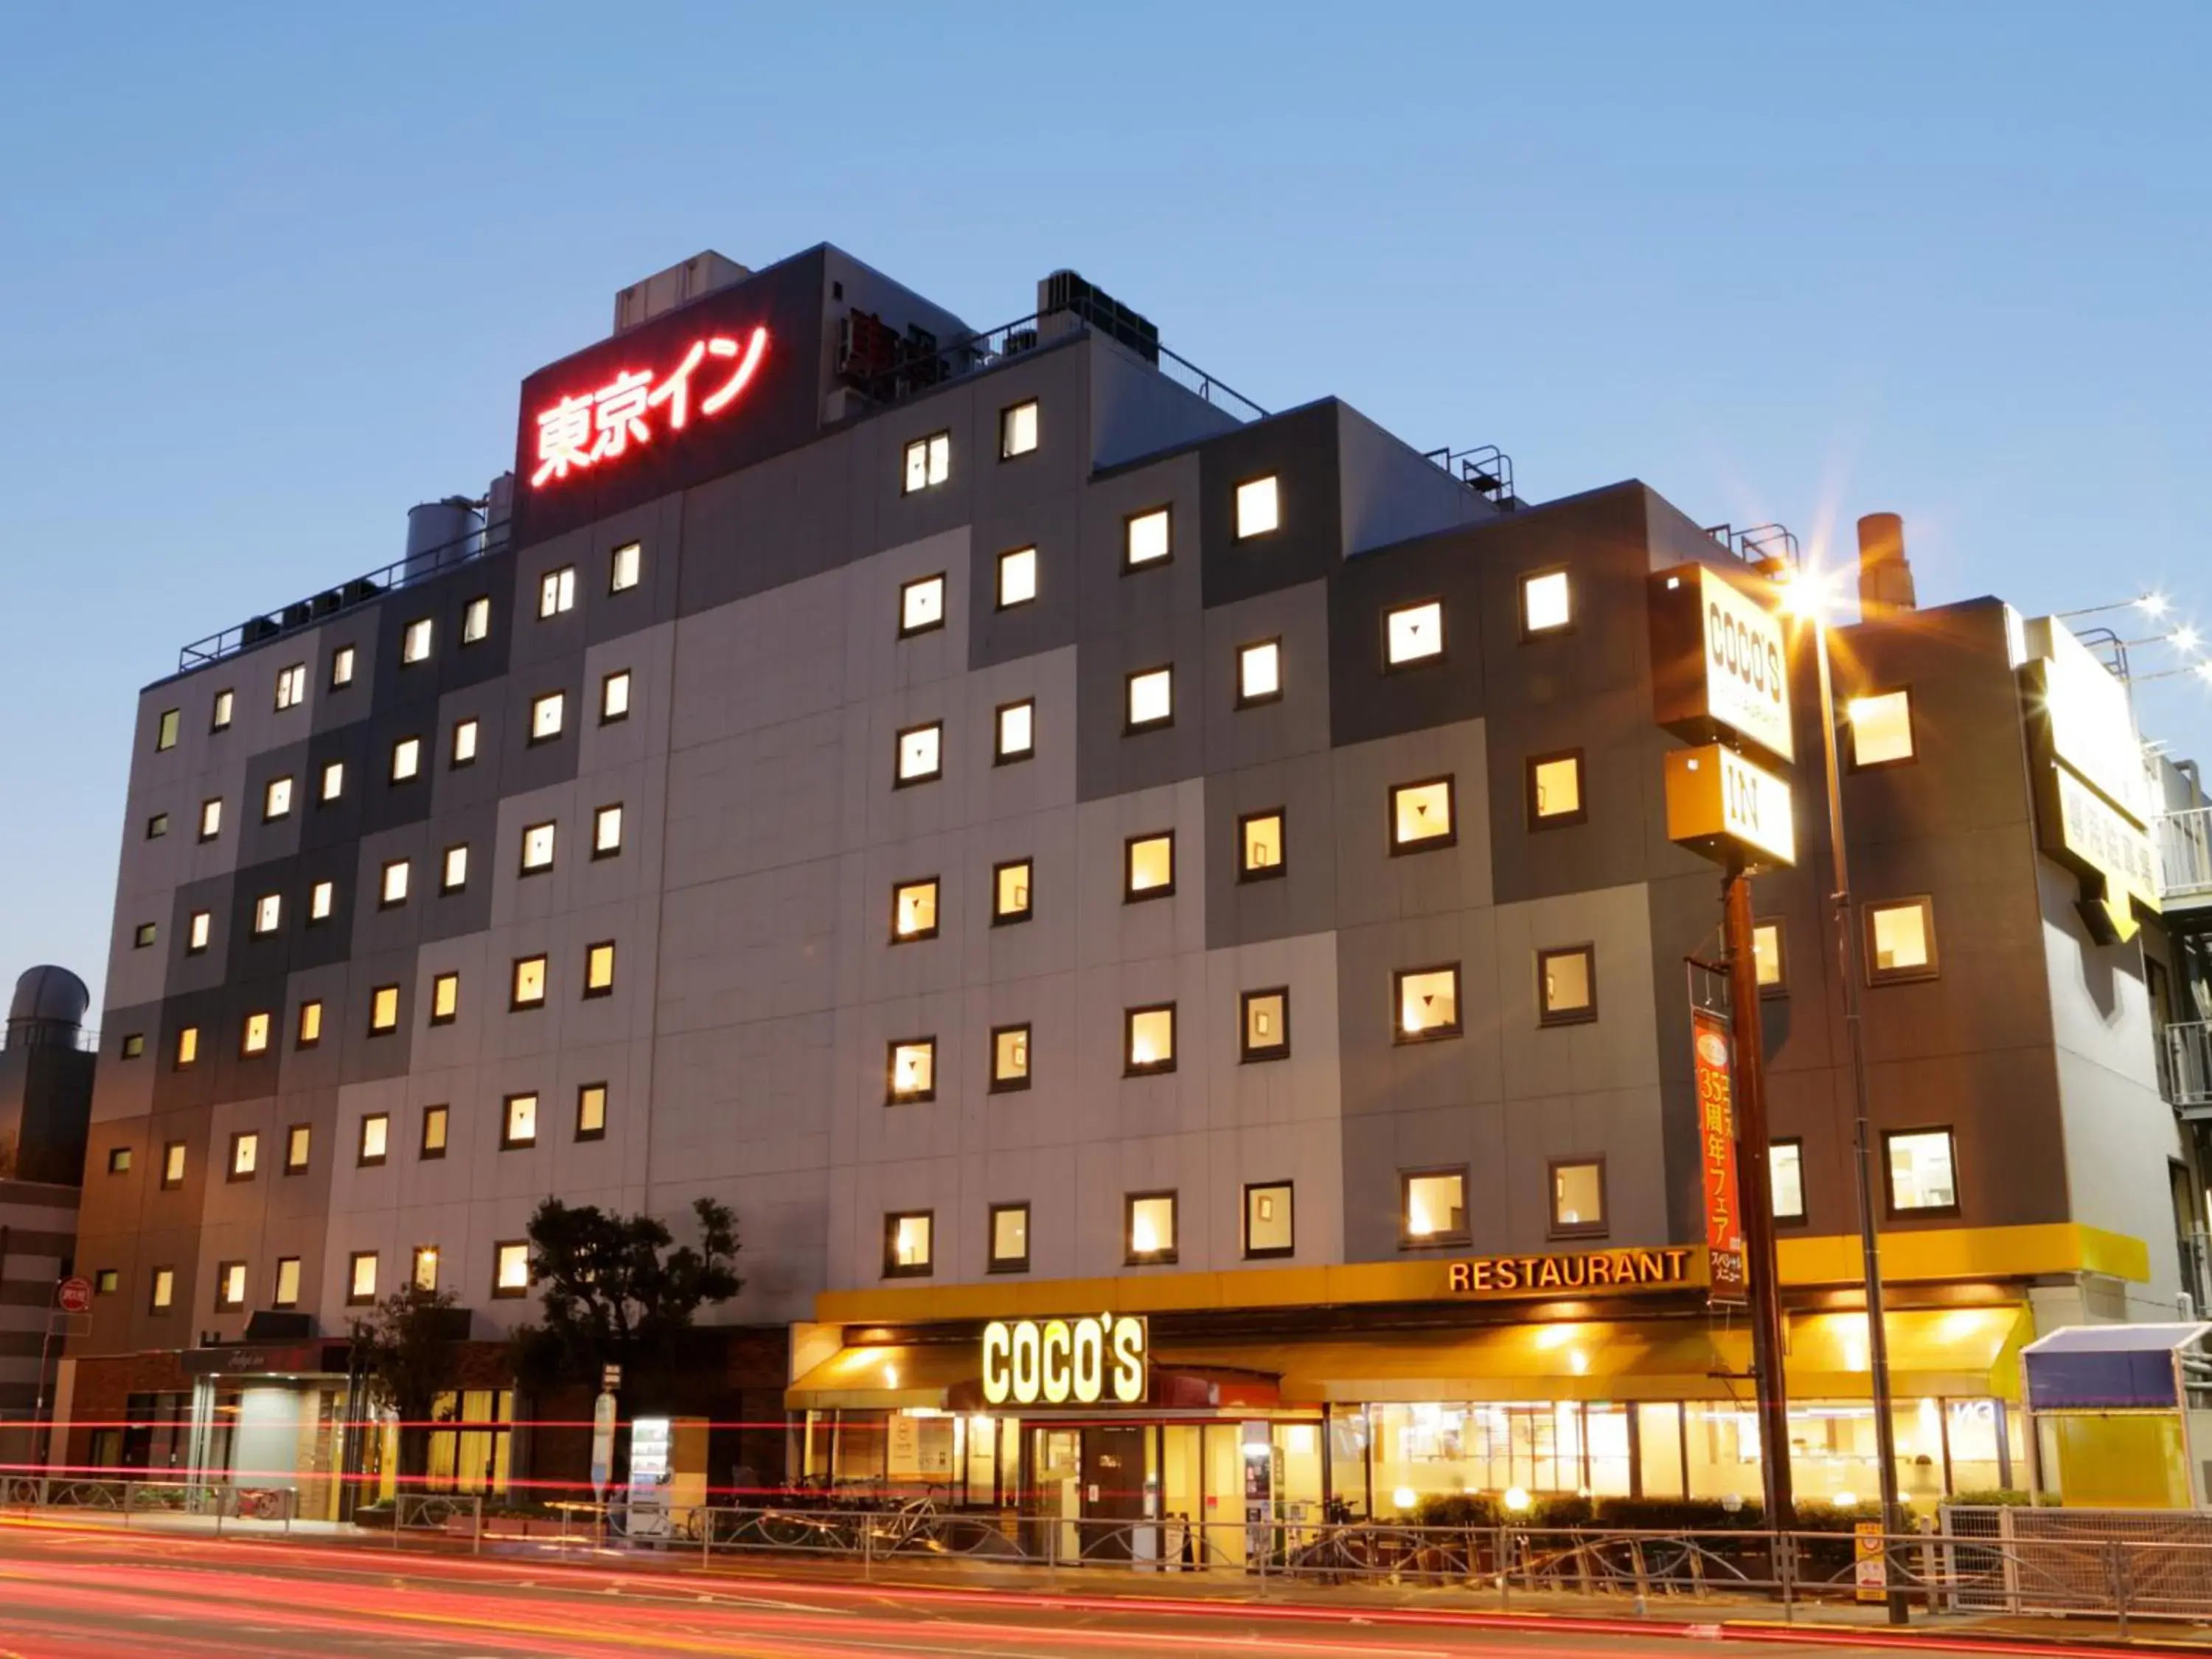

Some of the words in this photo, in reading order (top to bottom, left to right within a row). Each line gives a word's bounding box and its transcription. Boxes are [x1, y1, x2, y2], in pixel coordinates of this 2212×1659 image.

[531, 326, 768, 487] 東京イン
[1710, 601, 1781, 704] COCO'S
[1727, 764, 1759, 832] IN
[1450, 1251, 1686, 1290] RESTAURANT
[984, 1311, 1142, 1404] COCO'S
